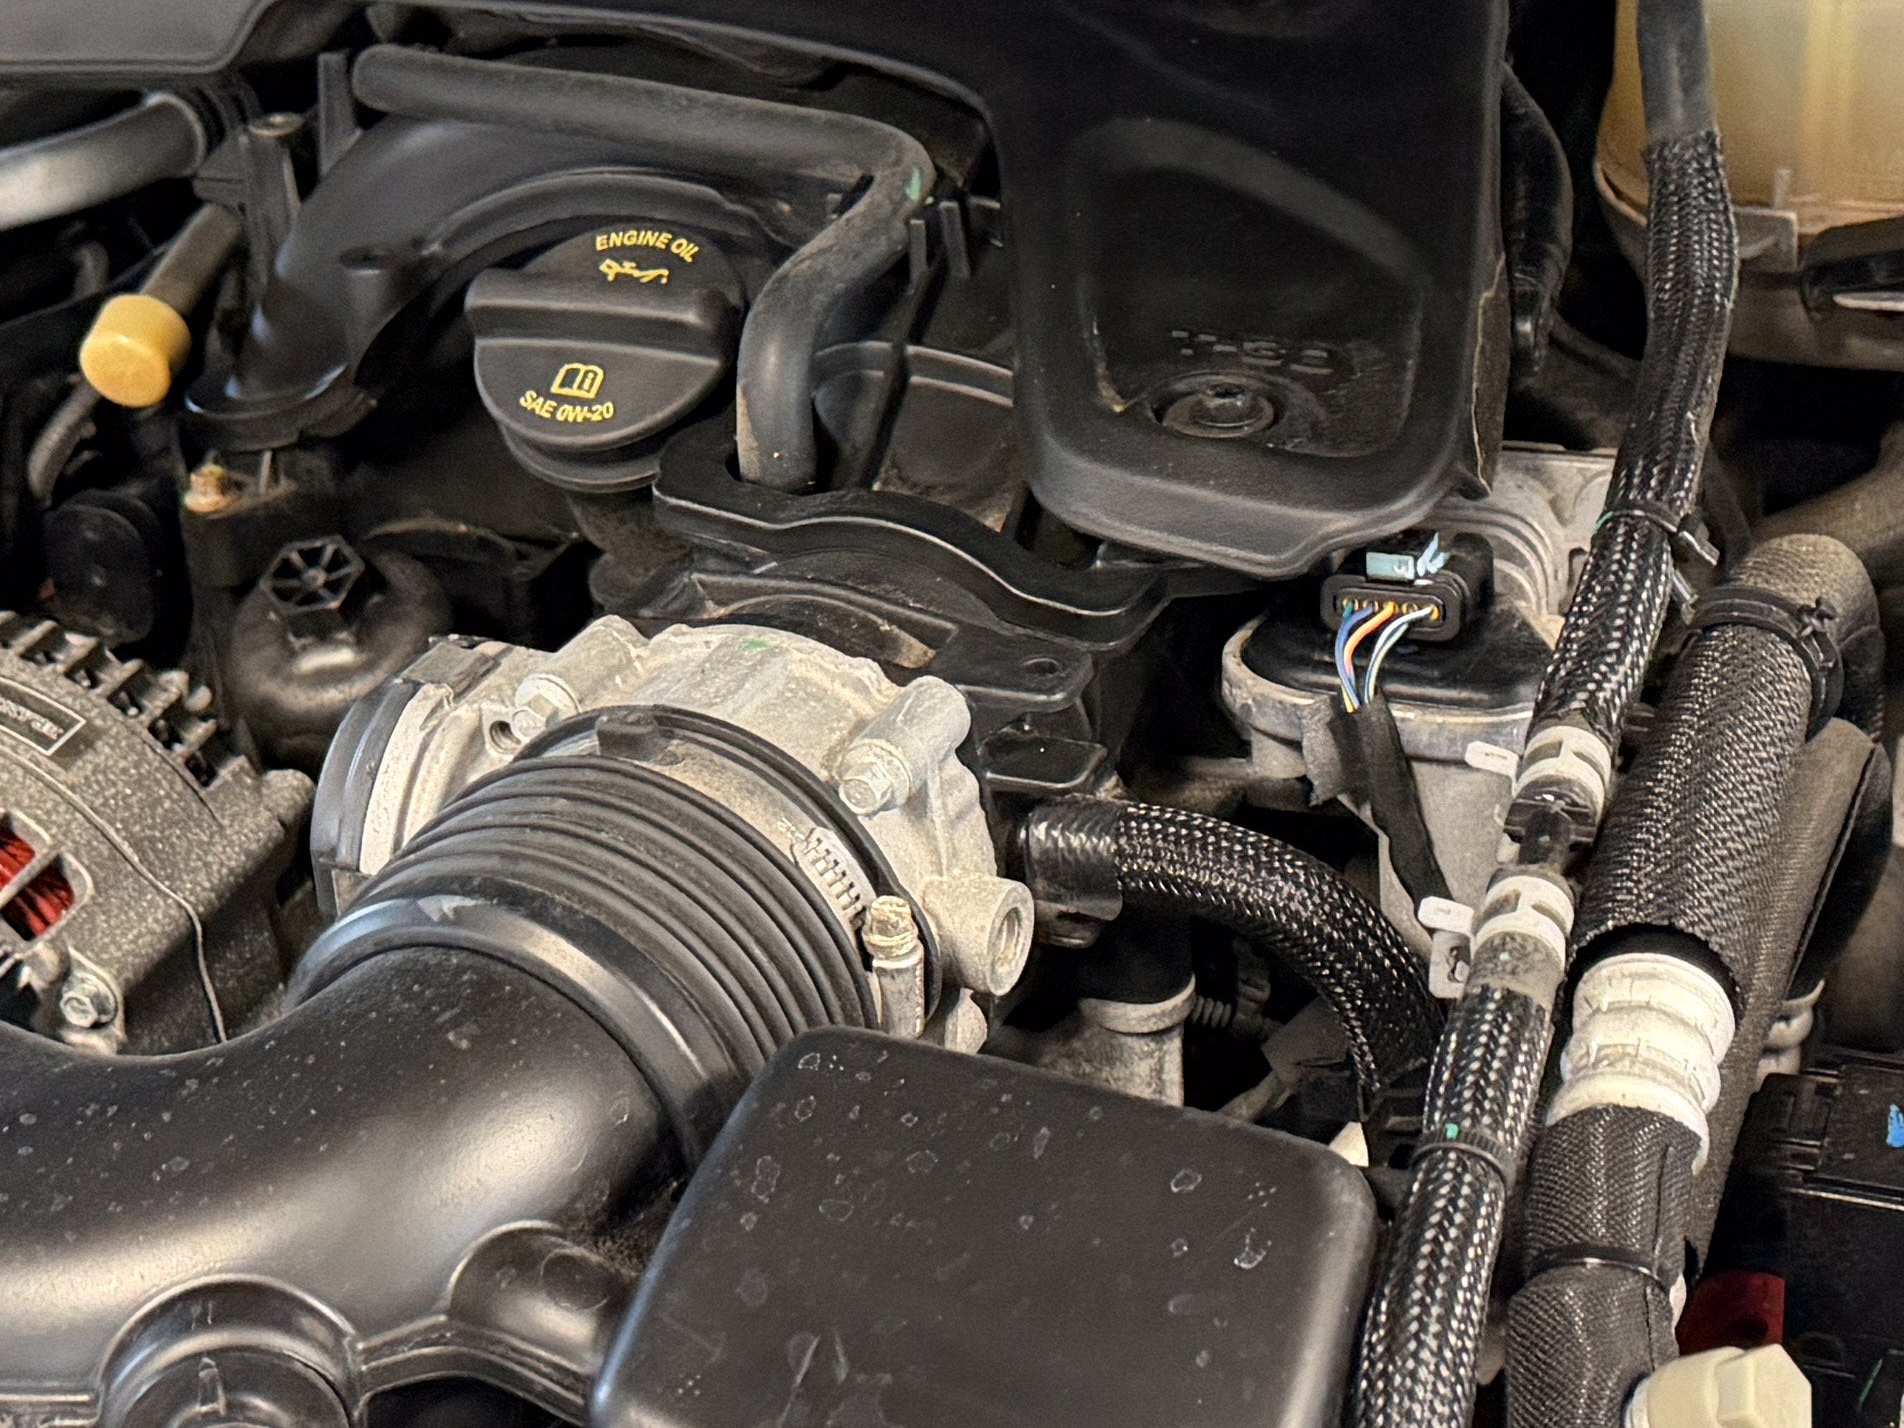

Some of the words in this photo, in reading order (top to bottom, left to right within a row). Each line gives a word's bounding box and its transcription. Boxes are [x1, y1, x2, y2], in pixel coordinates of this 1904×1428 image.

[595, 229, 673, 252] ENGINE
[670, 238, 700, 264] OIL
[519, 390, 558, 420] SAE
[556, 401, 615, 423] 0W-20
